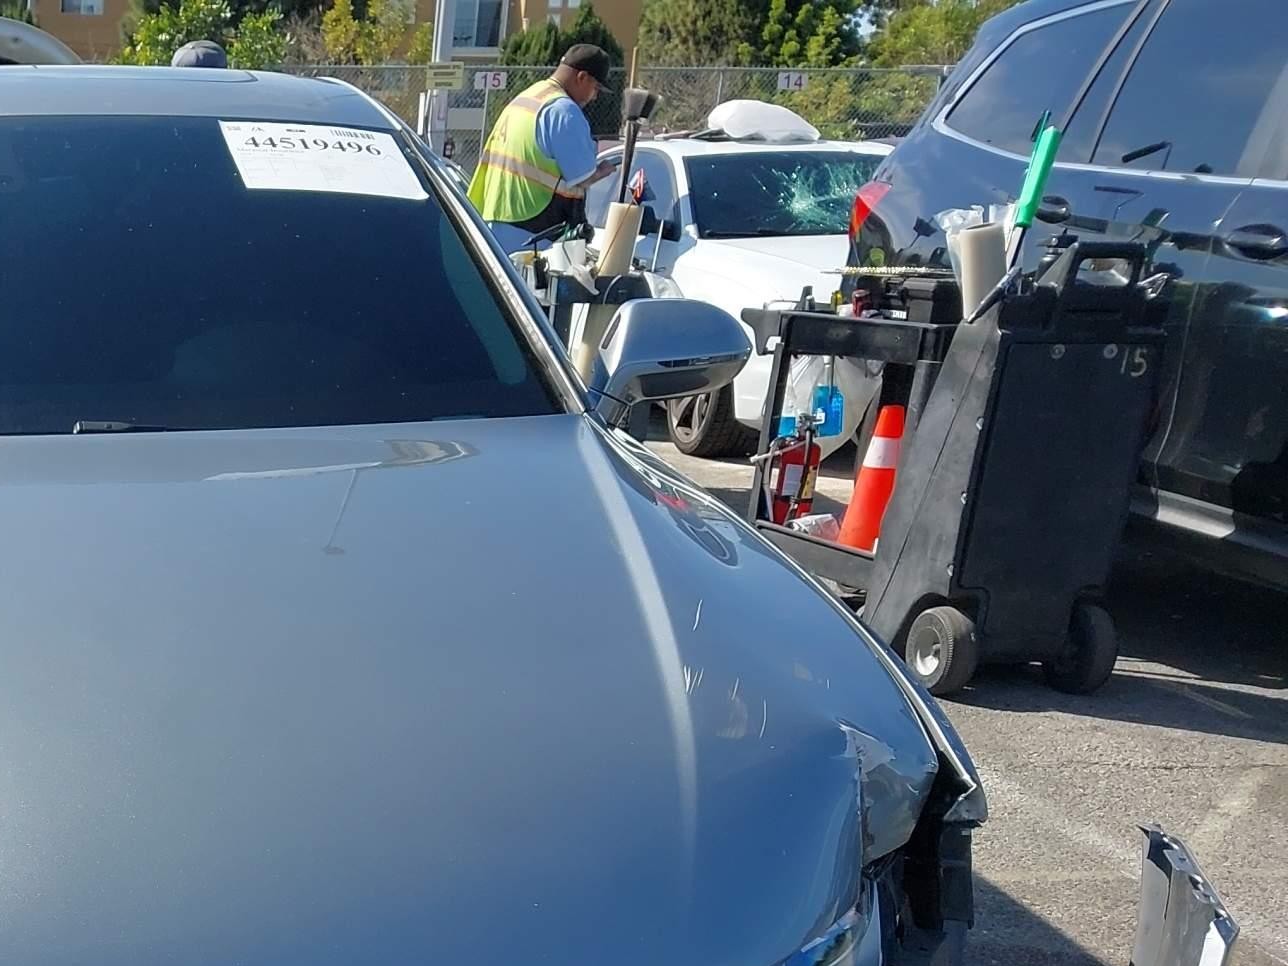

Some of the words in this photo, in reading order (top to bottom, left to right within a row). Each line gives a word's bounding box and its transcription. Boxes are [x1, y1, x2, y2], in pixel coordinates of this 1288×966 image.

[481, 73, 501, 88] 15
[784, 73, 803, 89] 14
[244, 135, 382, 156] 44519496
[1120, 346, 1148, 377] 15
